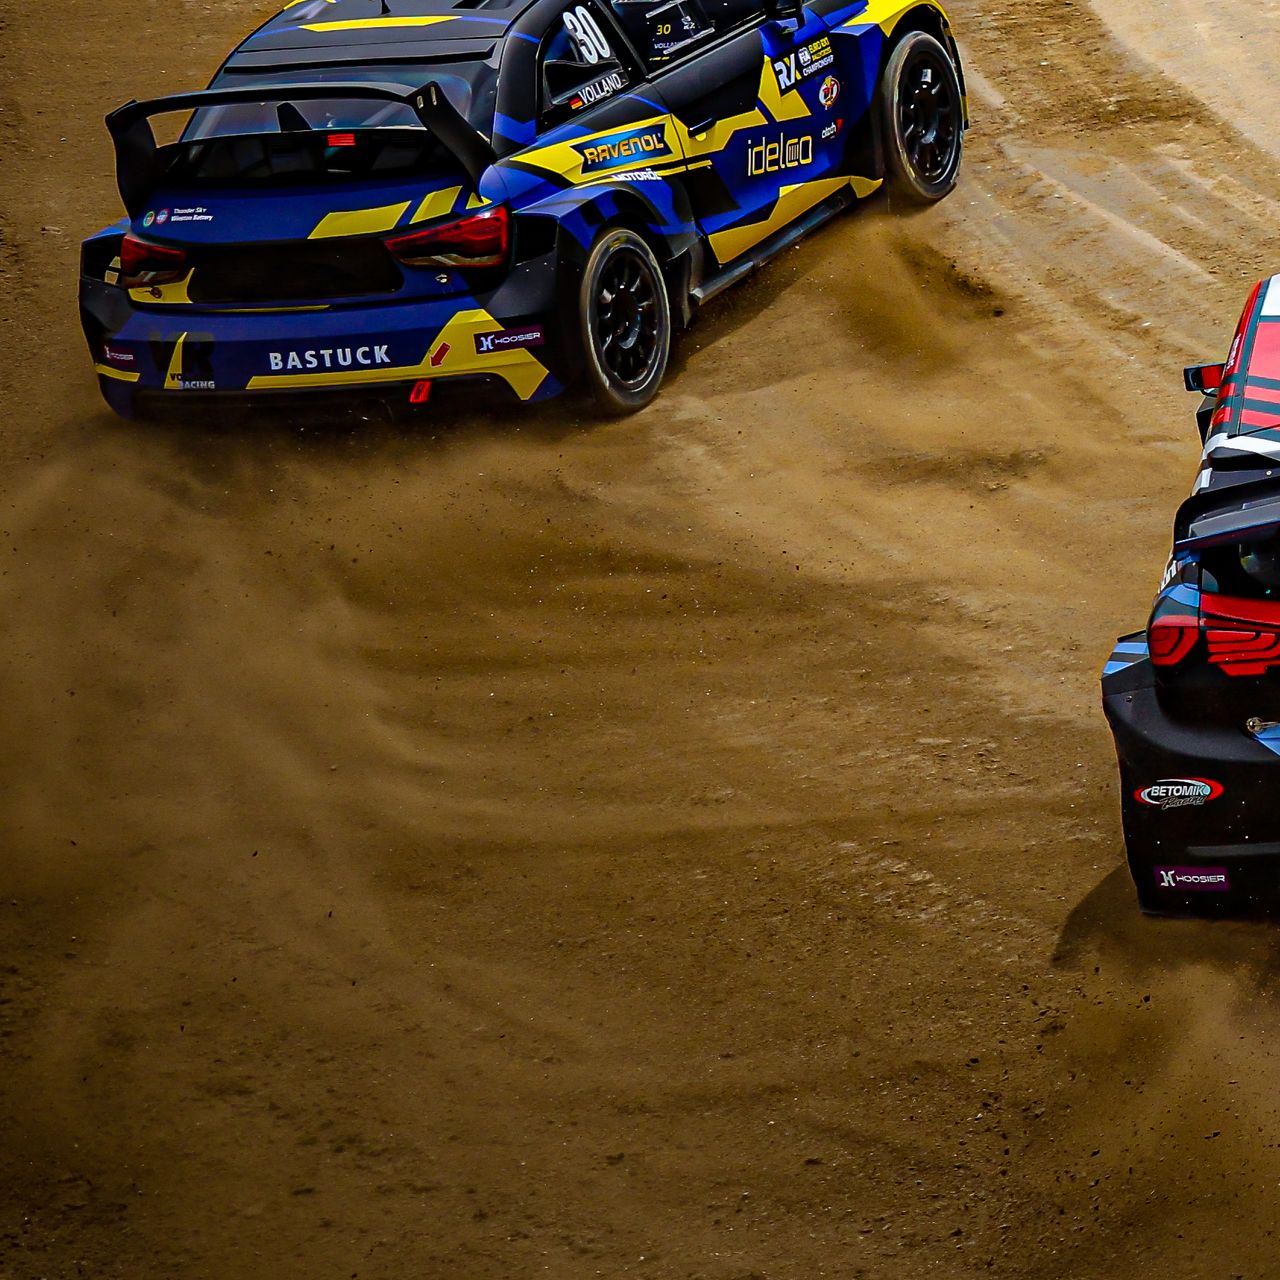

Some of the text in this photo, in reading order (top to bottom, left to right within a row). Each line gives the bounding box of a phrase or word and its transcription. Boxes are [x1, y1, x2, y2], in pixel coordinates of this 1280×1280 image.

[562, 5, 611, 64] 30
[656, 24, 672, 36] 30
[774, 53, 802, 90] RX
[802, 55, 834, 77] CHAMPIONSHIP
[578, 73, 622, 105] VOLLAND
[584, 133, 664, 164] RAVENOL
[495, 331, 541, 345] HOOSIER
[269, 344, 391, 371] BASTUCK
[1151, 785, 1210, 798] BETOMIK
[1160, 794, 1207, 810] Racing
[1175, 874, 1226, 883] HOOSIER
